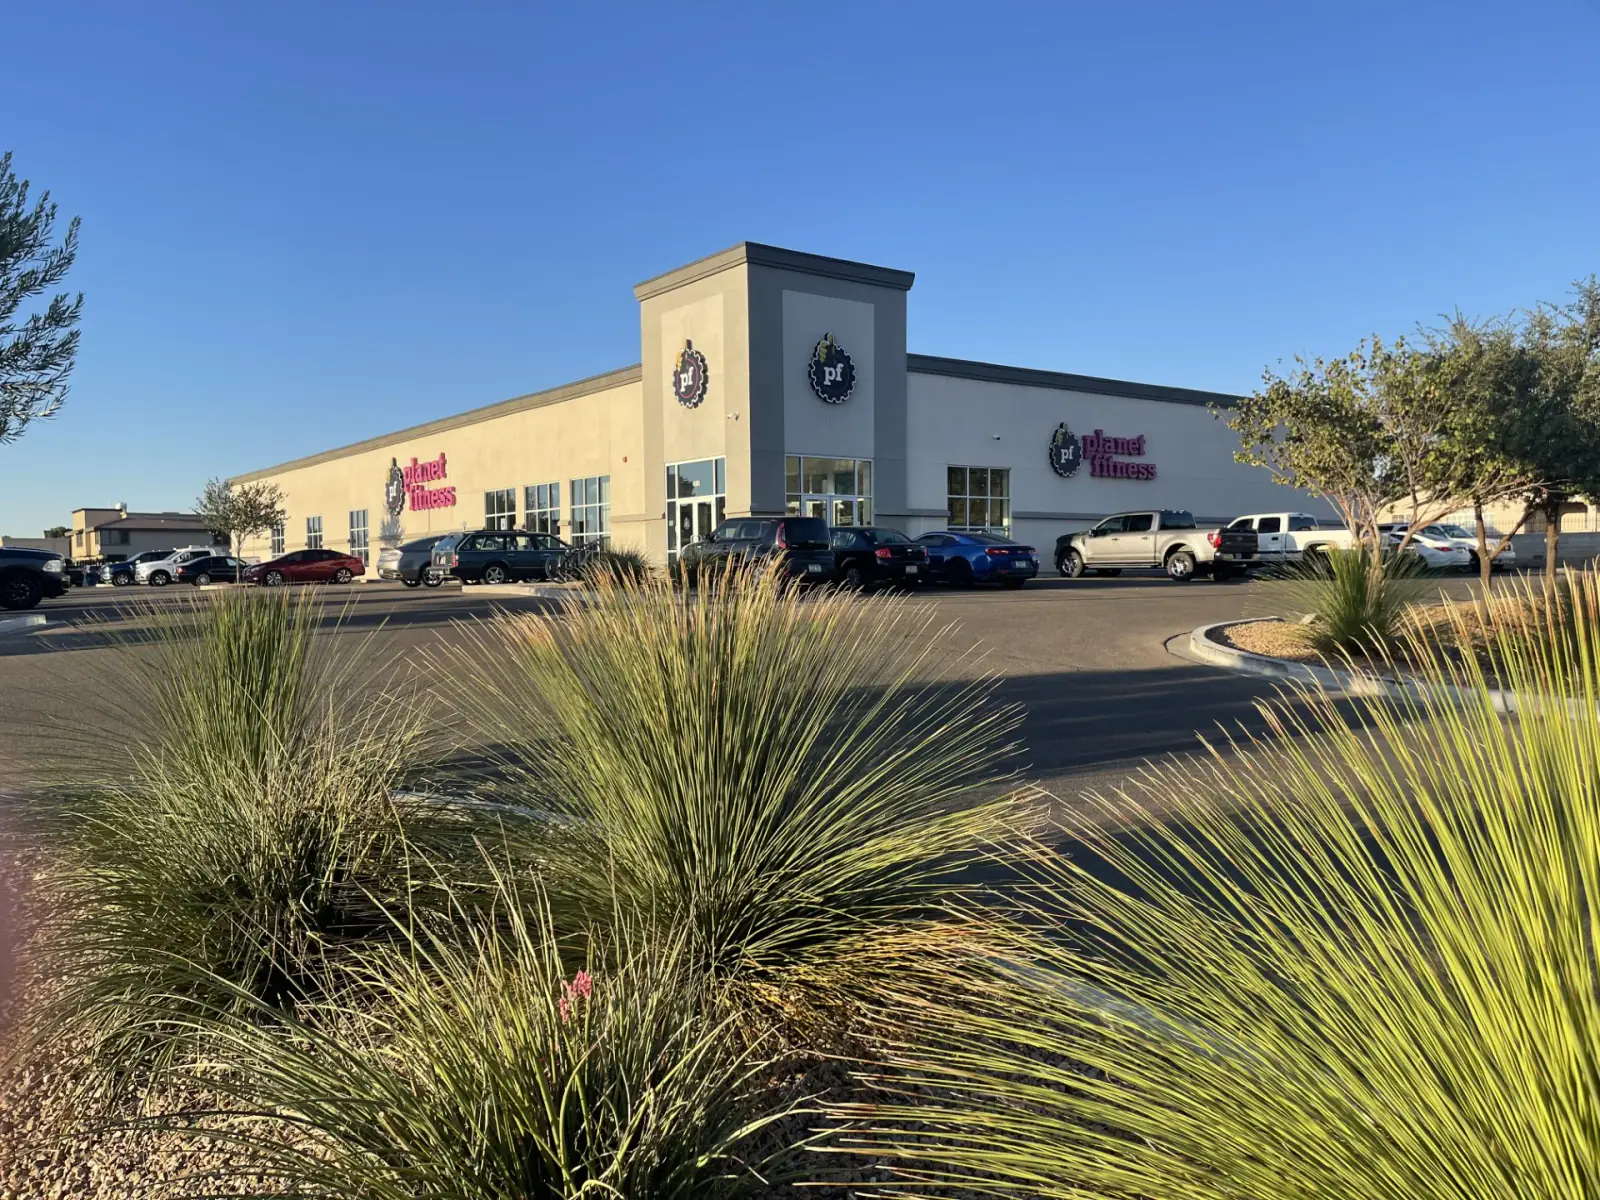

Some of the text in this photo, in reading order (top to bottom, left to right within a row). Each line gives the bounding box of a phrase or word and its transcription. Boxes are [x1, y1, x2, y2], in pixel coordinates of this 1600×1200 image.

[680, 366, 694, 392] pf
[823, 362, 844, 385] pf
[1060, 445, 1074, 463] pf
[1082, 429, 1145, 459] planet
[403, 452, 447, 492] planet
[1090, 453, 1156, 480] fitness
[389, 480, 397, 502] pf
[409, 484, 456, 511] fitness
